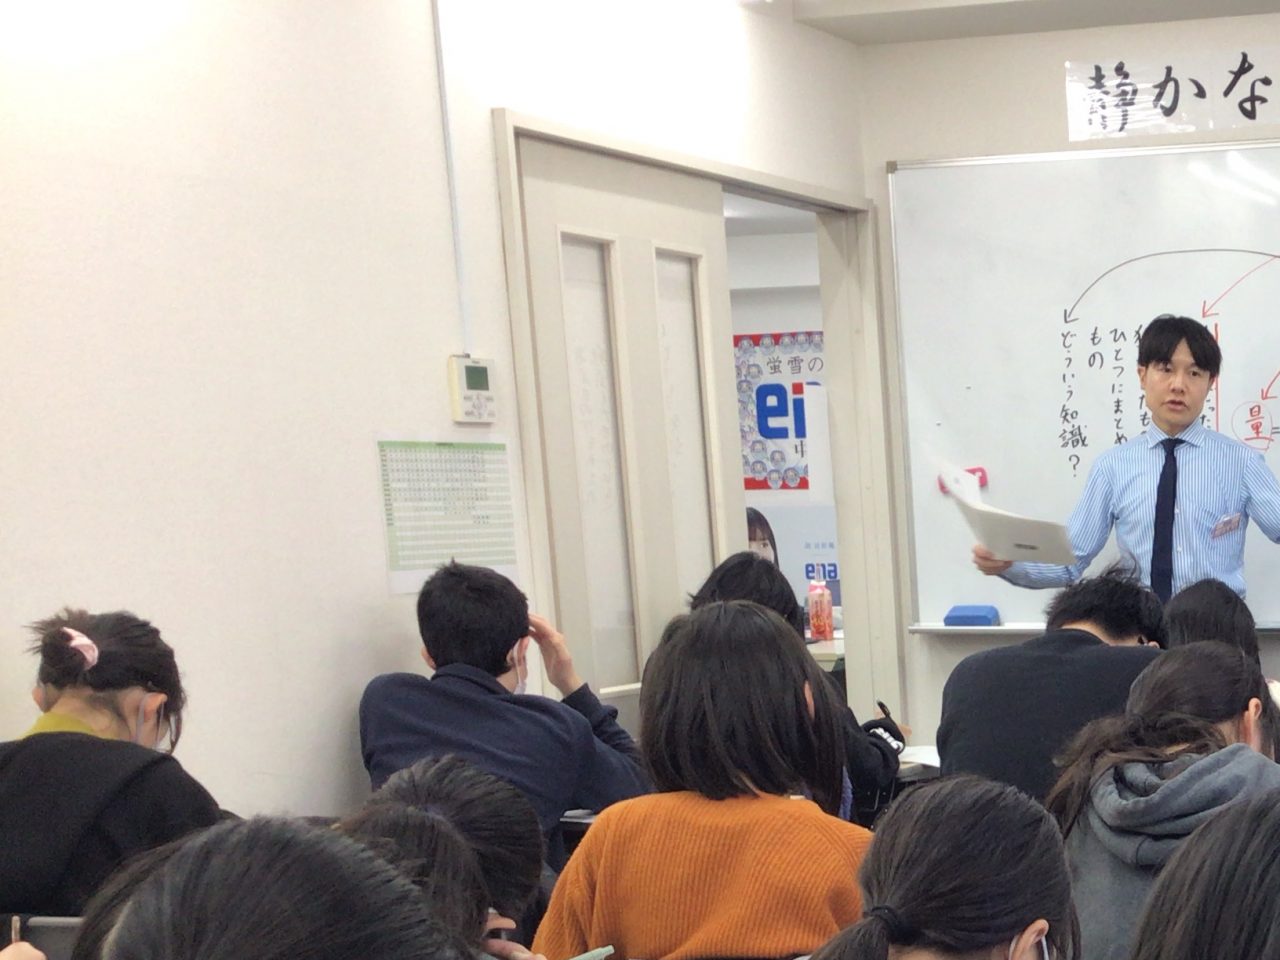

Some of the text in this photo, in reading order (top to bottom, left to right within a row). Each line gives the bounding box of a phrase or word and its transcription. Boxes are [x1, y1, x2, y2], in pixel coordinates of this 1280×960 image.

[1087, 326, 1105, 370] もの
[766, 355, 824, 375] 蛍雪の
[1245, 404, 1264, 437] 量
[804, 563, 838, 580] ena
